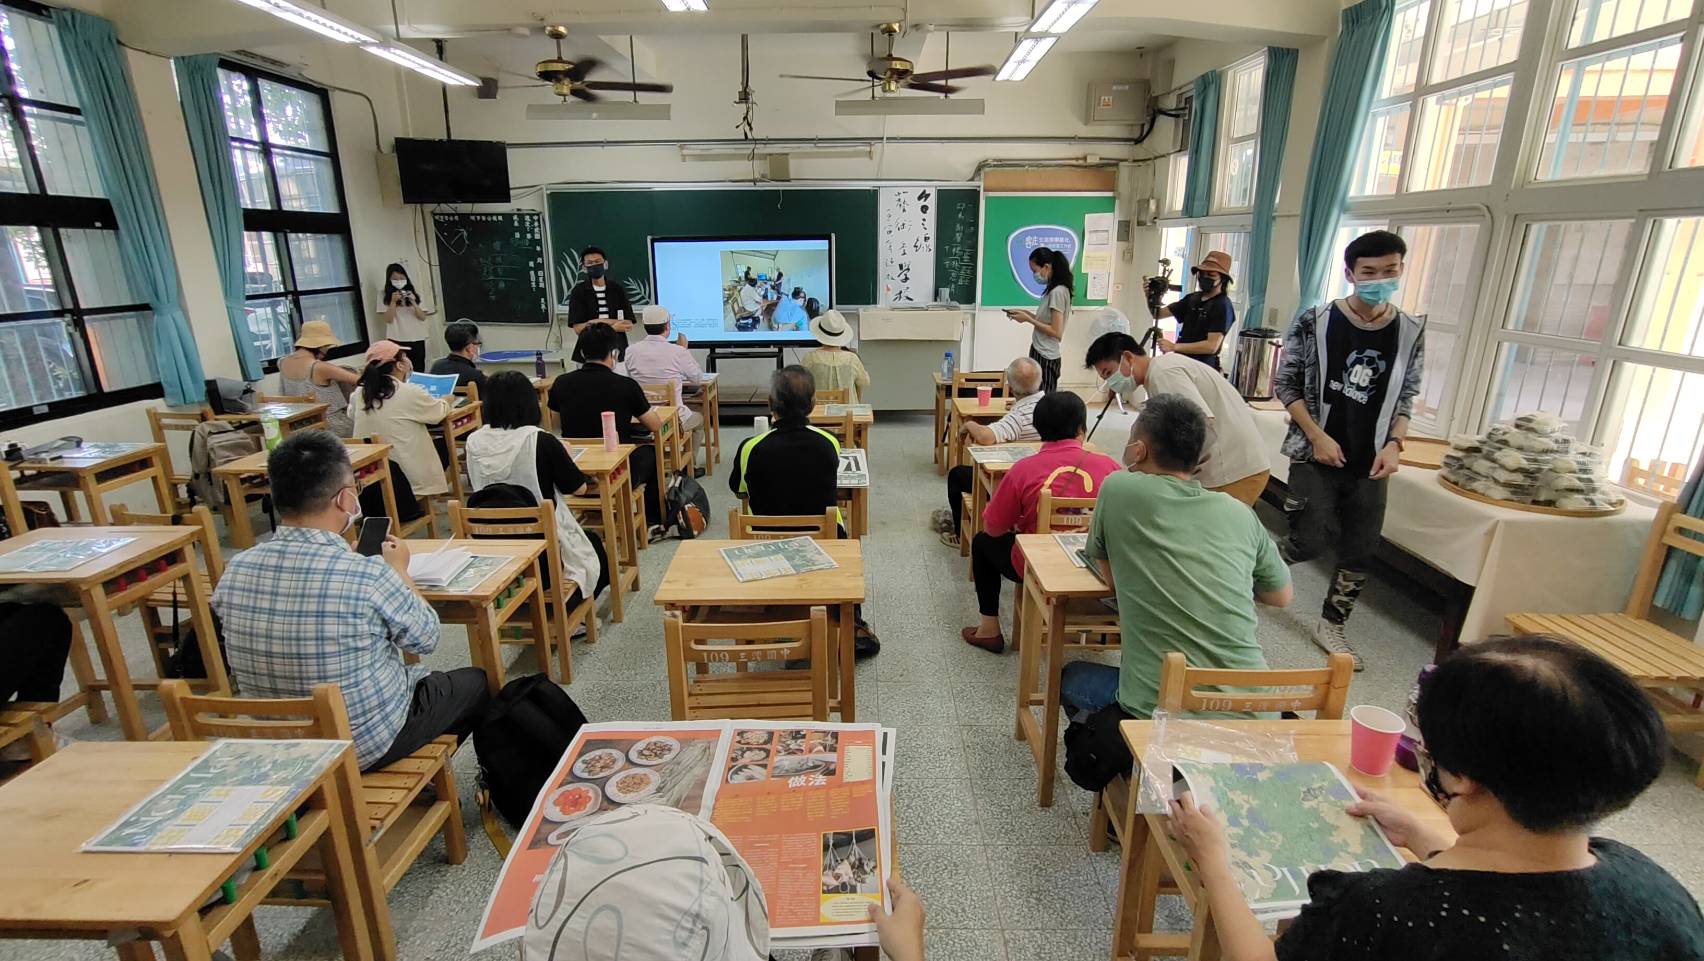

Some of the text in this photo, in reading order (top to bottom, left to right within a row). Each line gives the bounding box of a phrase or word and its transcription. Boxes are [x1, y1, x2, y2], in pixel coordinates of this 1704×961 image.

[703, 651, 729, 663] 109
[1200, 697, 1232, 712] 109
[787, 774, 828, 789] 做法
